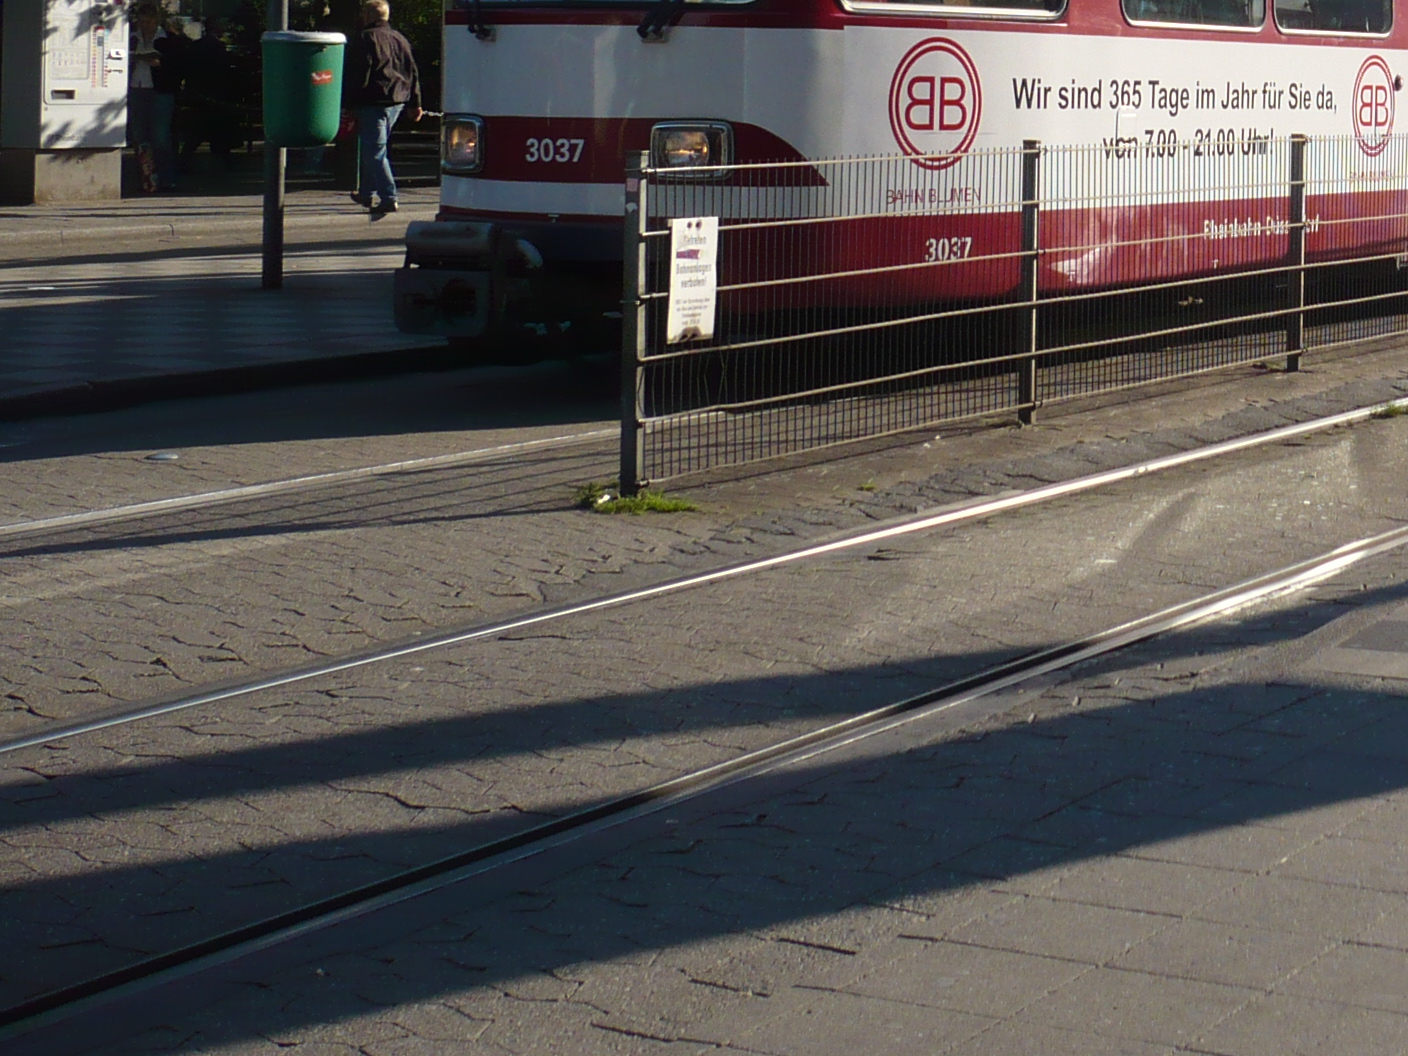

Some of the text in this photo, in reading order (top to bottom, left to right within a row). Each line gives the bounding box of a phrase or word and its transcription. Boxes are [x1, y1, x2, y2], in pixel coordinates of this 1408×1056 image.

[1012, 78, 1337, 117] Wir sind 365 Tage im Jahr für Sie da,
[525, 137, 585, 163] 3037
[1102, 136, 1138, 159] von
[1144, 128, 1178, 158] 7.00
[1194, 128, 1236, 157] 21.00
[1241, 128, 1274, 156] Uhr!
[925, 236, 973, 262] 3037
